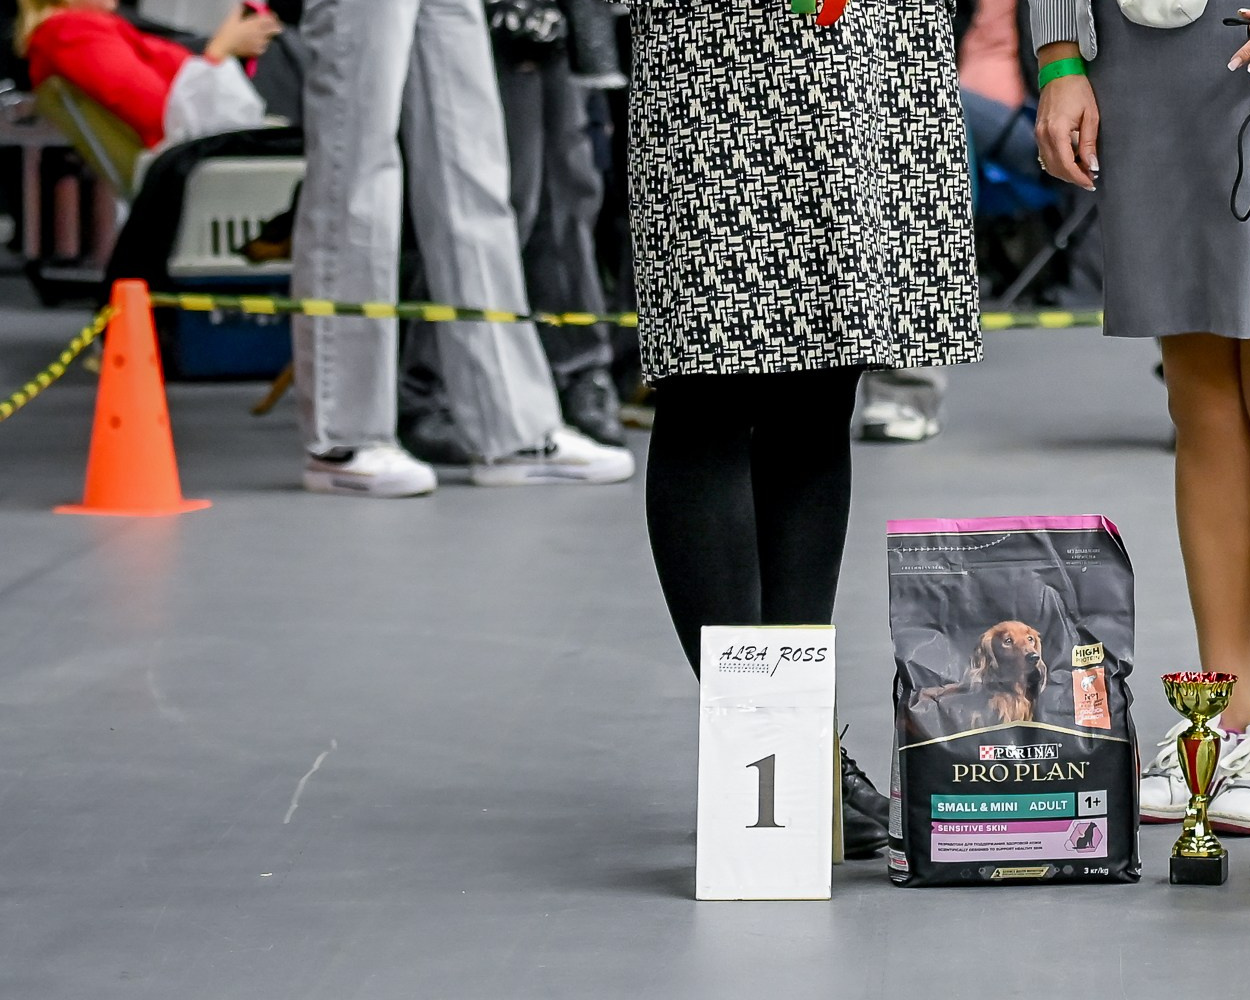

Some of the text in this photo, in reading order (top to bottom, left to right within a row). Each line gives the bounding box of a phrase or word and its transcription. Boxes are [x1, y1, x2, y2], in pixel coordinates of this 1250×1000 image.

[1075, 646, 1100, 657] HIGH
[719, 645, 768, 661] ALBA
[770, 646, 827, 677] ROSS
[996, 745, 1055, 759] PURINA
[952, 761, 1086, 783] PRO PLAN
[745, 753, 786, 828] 1
[937, 800, 1067, 812] SMALL & MINI ADULT
[1084, 796, 1101, 809] 1+
[938, 824, 1007, 832] SENSITIVE SKIN
[1083, 867, 1089, 875] 3
